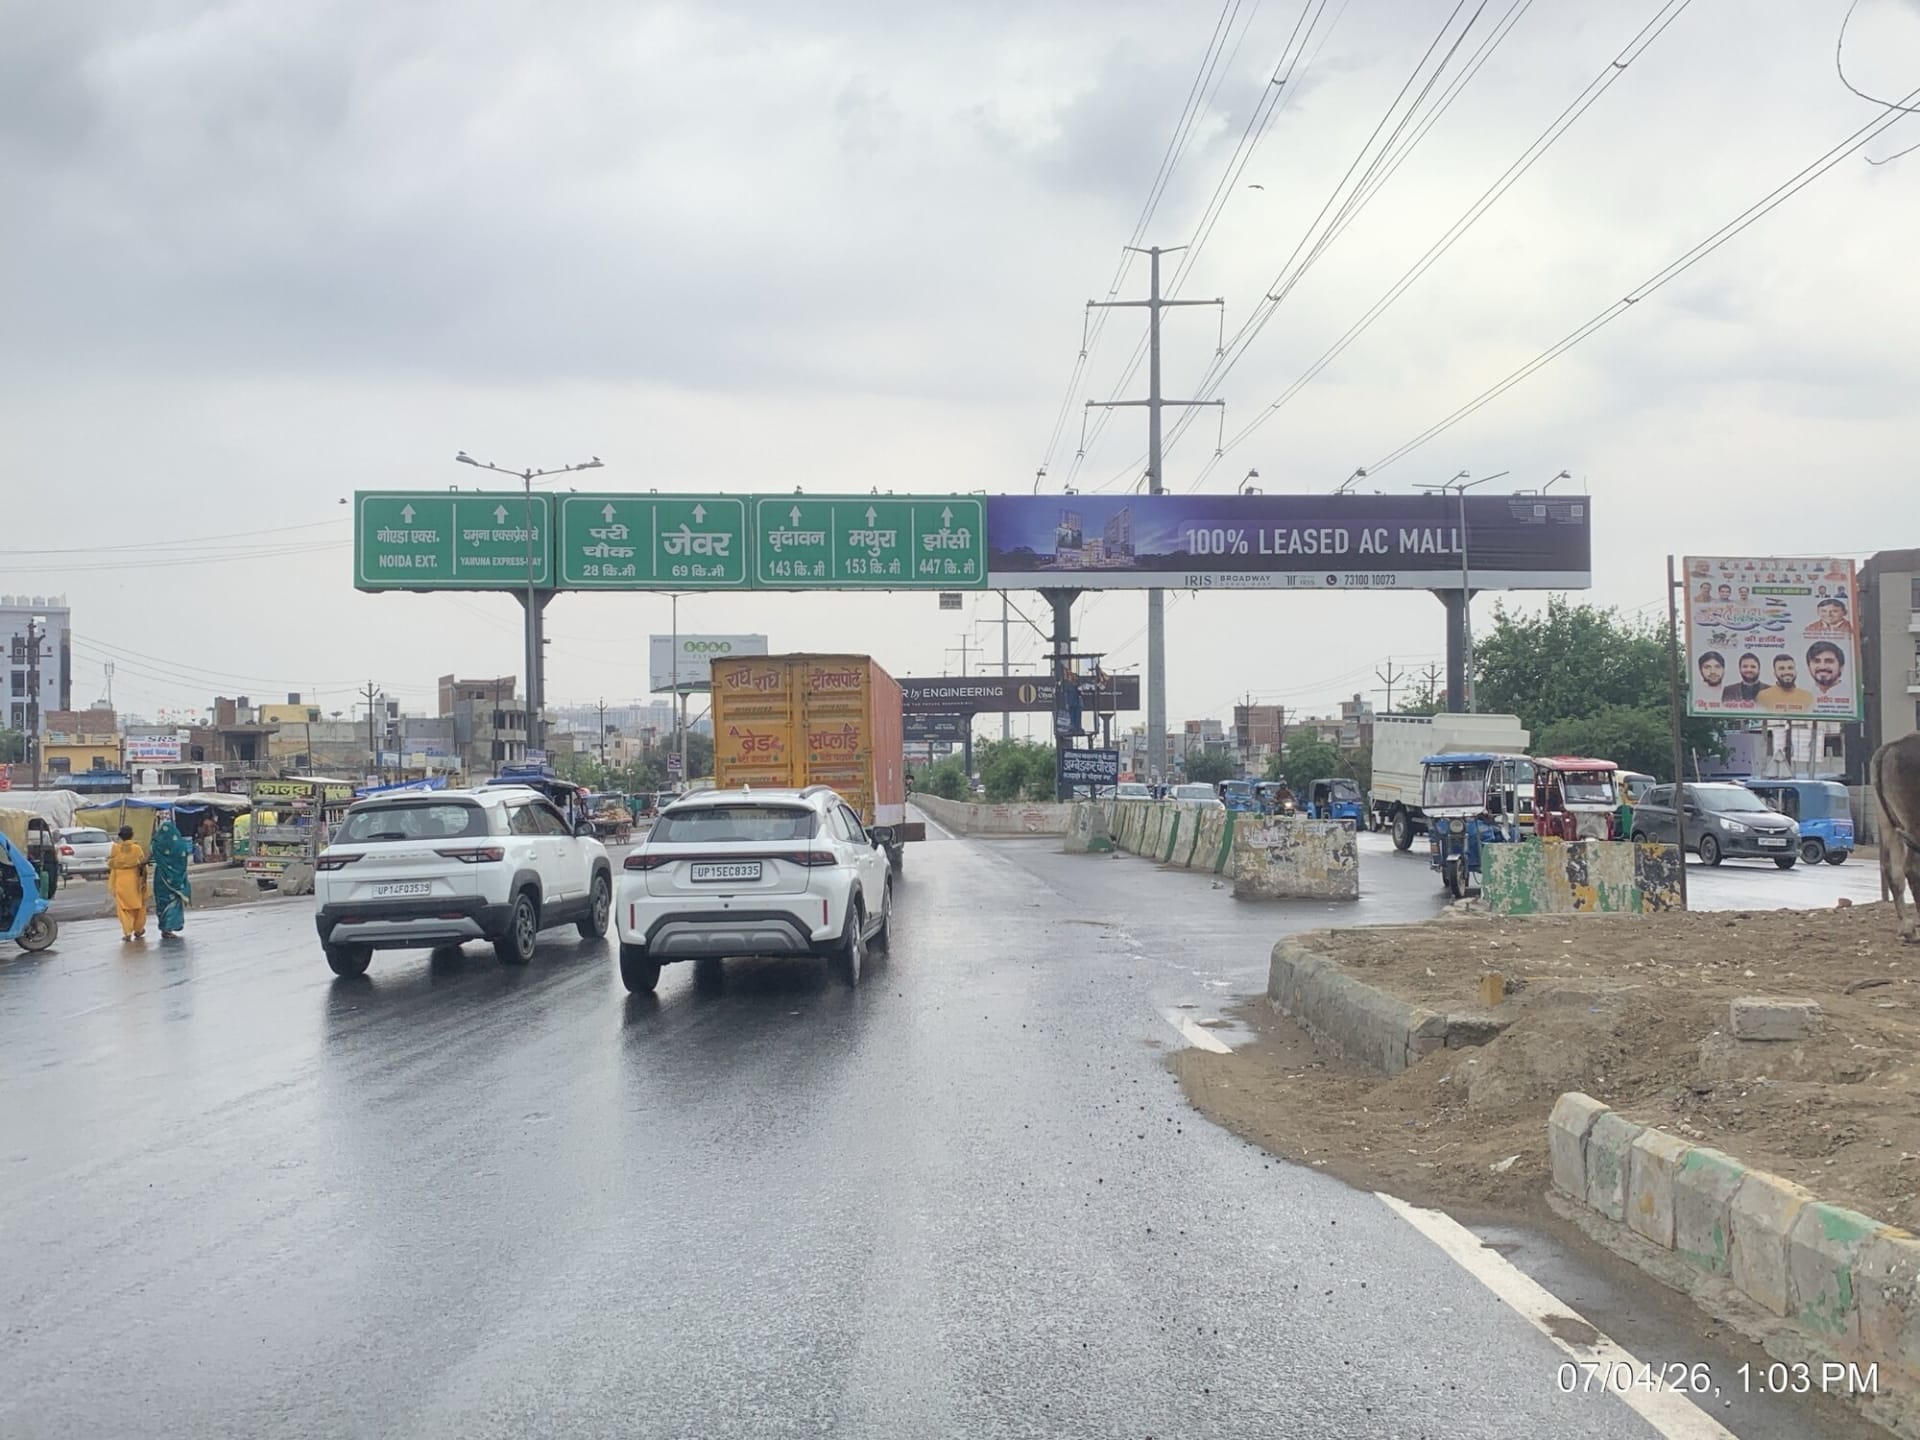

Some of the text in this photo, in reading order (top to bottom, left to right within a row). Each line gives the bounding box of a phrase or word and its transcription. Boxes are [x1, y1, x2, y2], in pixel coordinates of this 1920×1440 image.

[377, 526, 440, 544] नोएडा एक्स.
[463, 528, 490, 547] यमुना
[589, 524, 630, 540] परी
[661, 523, 733, 557] जेवर
[768, 526, 826, 552] वृंदावन
[848, 529, 896, 557] मथुरा
[1186, 528, 1464, 555] 100% LEASED AC MALL
[379, 555, 438, 567] NOIDA EXT.
[460, 556, 490, 566] YAMUNA
[769, 561, 791, 576] 143
[845, 558, 866, 574] 153
[919, 558, 941, 574] 447
[583, 564, 599, 576] 28
[672, 565, 688, 577] 69
[1184, 575, 1212, 586] IRIS
[1344, 575, 1396, 586] 73100 10073
[923, 687, 1003, 698] ENGINEERING
